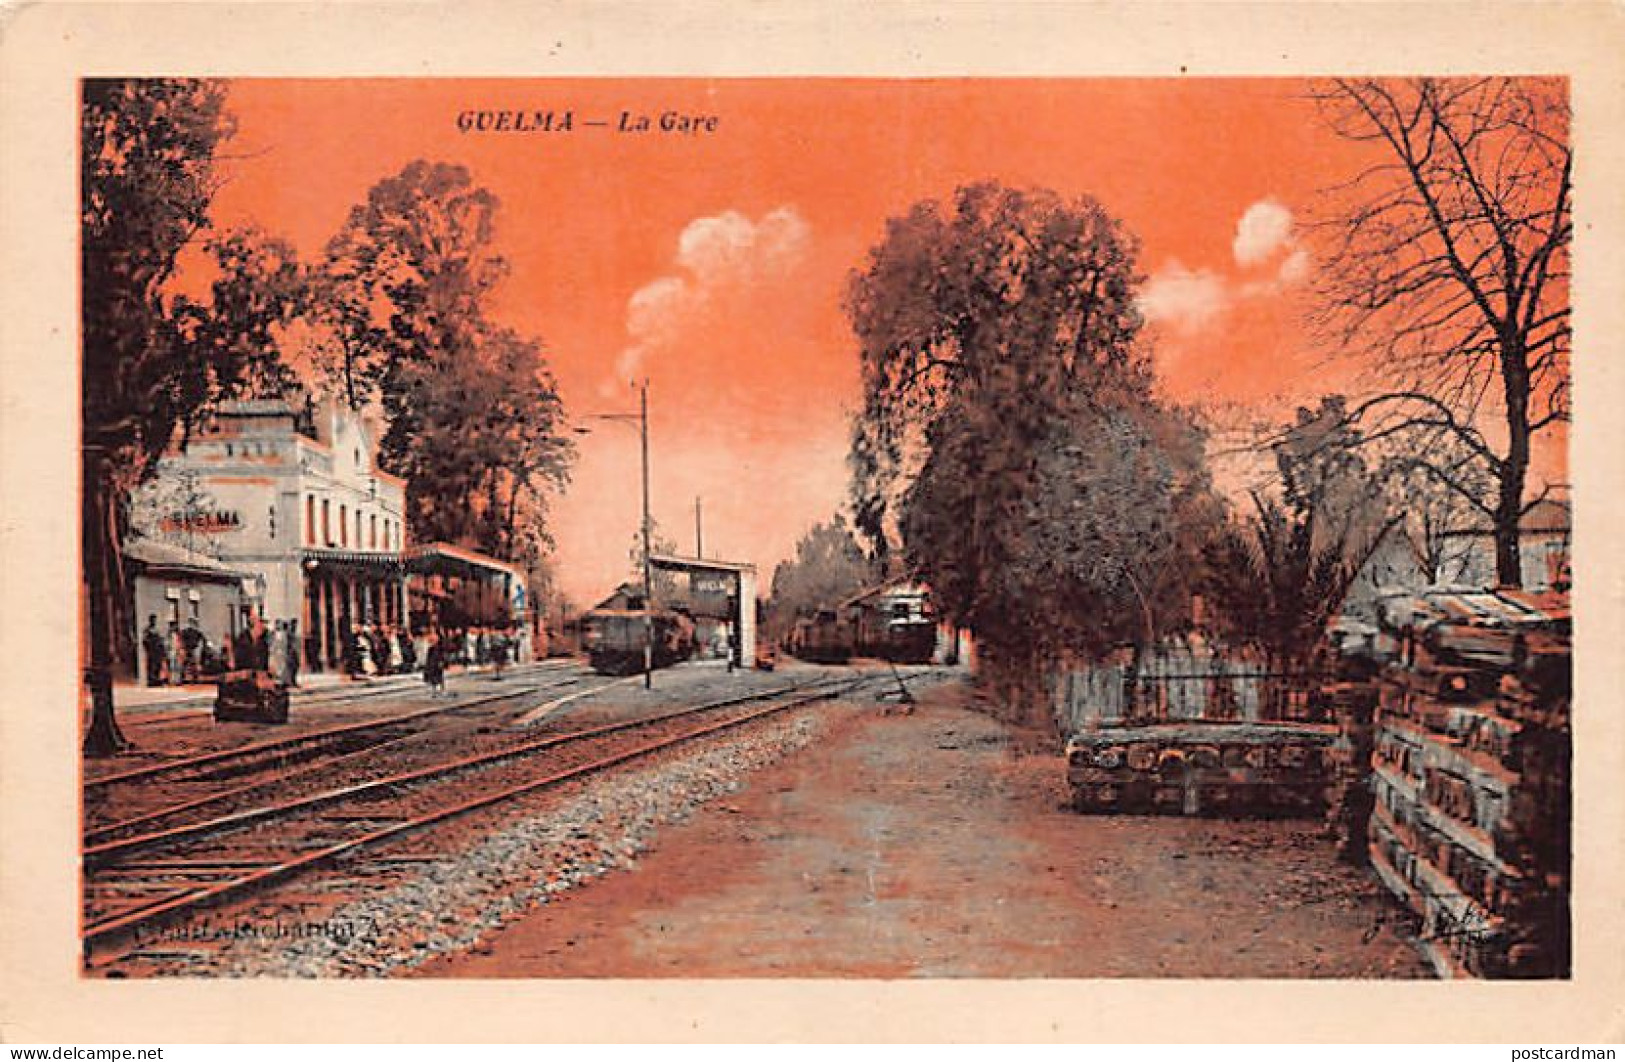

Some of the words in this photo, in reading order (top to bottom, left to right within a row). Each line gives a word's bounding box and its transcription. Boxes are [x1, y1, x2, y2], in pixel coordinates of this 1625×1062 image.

[456, 110, 573, 132] GUELMA
[618, 110, 650, 132] La
[659, 110, 719, 134] Gare
